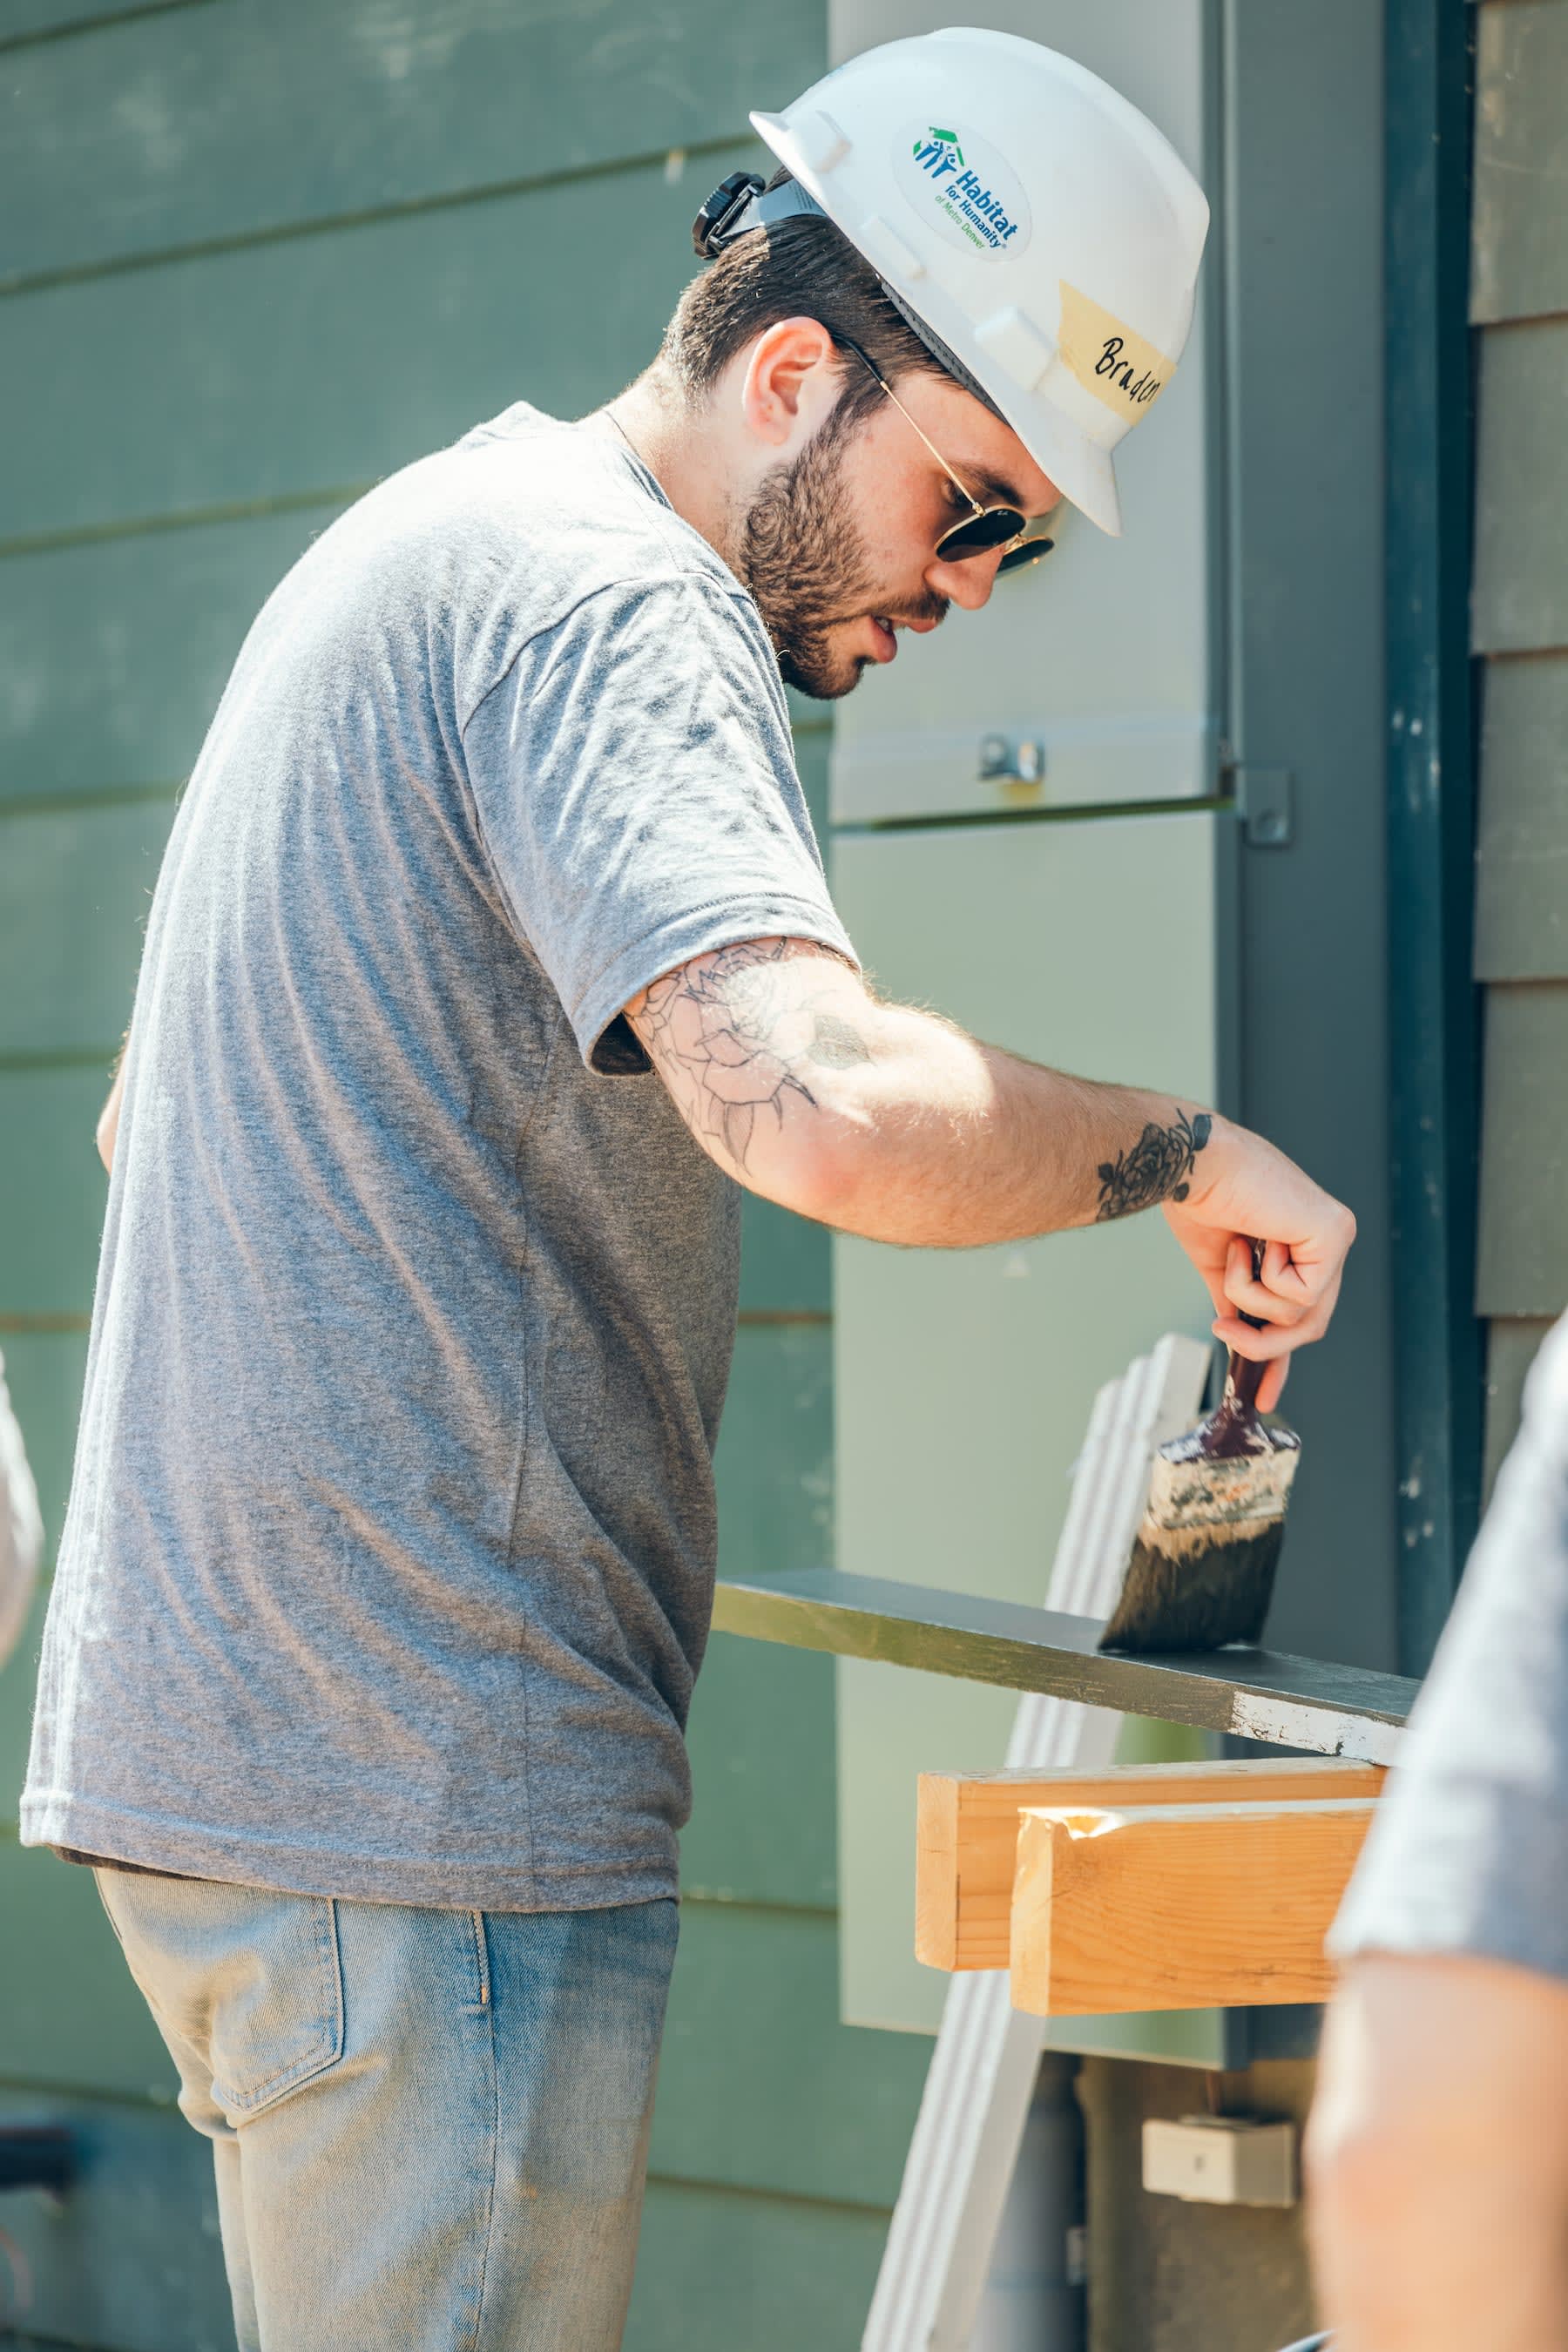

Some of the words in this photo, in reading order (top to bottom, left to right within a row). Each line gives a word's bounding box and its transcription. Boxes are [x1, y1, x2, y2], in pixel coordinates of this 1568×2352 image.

[935, 195, 946, 204] of
[943, 201, 963, 225] Metro
[961, 222, 985, 249] Denver
[945, 185, 961, 200] for
[958, 199, 1002, 248] Humanity
[956, 170, 1017, 240] Habitat
